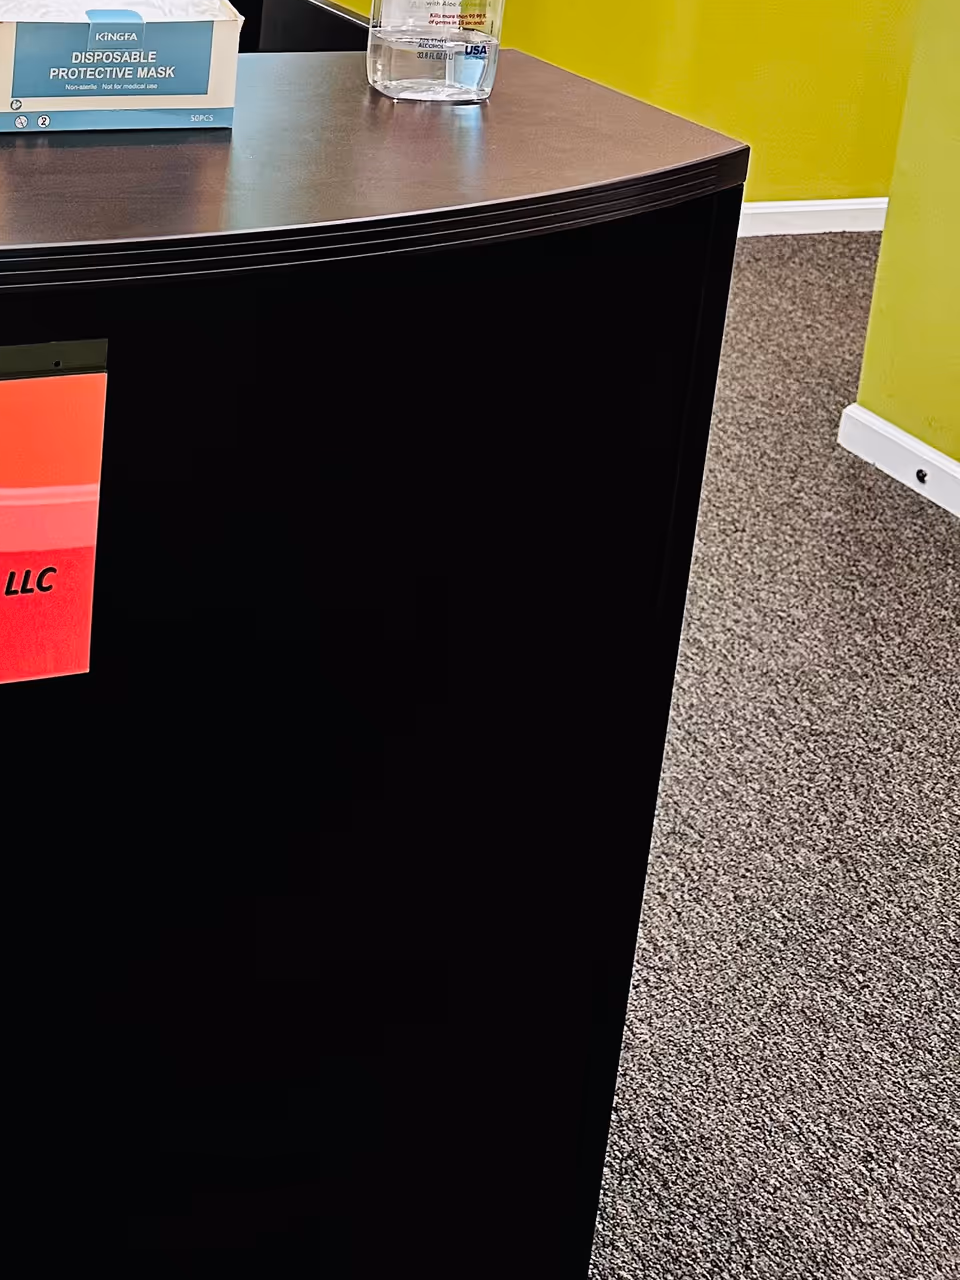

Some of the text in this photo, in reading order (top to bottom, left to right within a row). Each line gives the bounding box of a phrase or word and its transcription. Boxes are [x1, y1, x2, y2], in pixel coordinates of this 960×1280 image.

[464, 44, 487, 56] USA
[71, 51, 157, 64] DISPOSABLE
[49, 66, 176, 80] PROTECTIVE MASK
[65, 83, 97, 91] Non-sterile
[123, 82, 146, 90] medical
[190, 114, 214, 122] 50PCS
[4, 566, 58, 598] LLC
